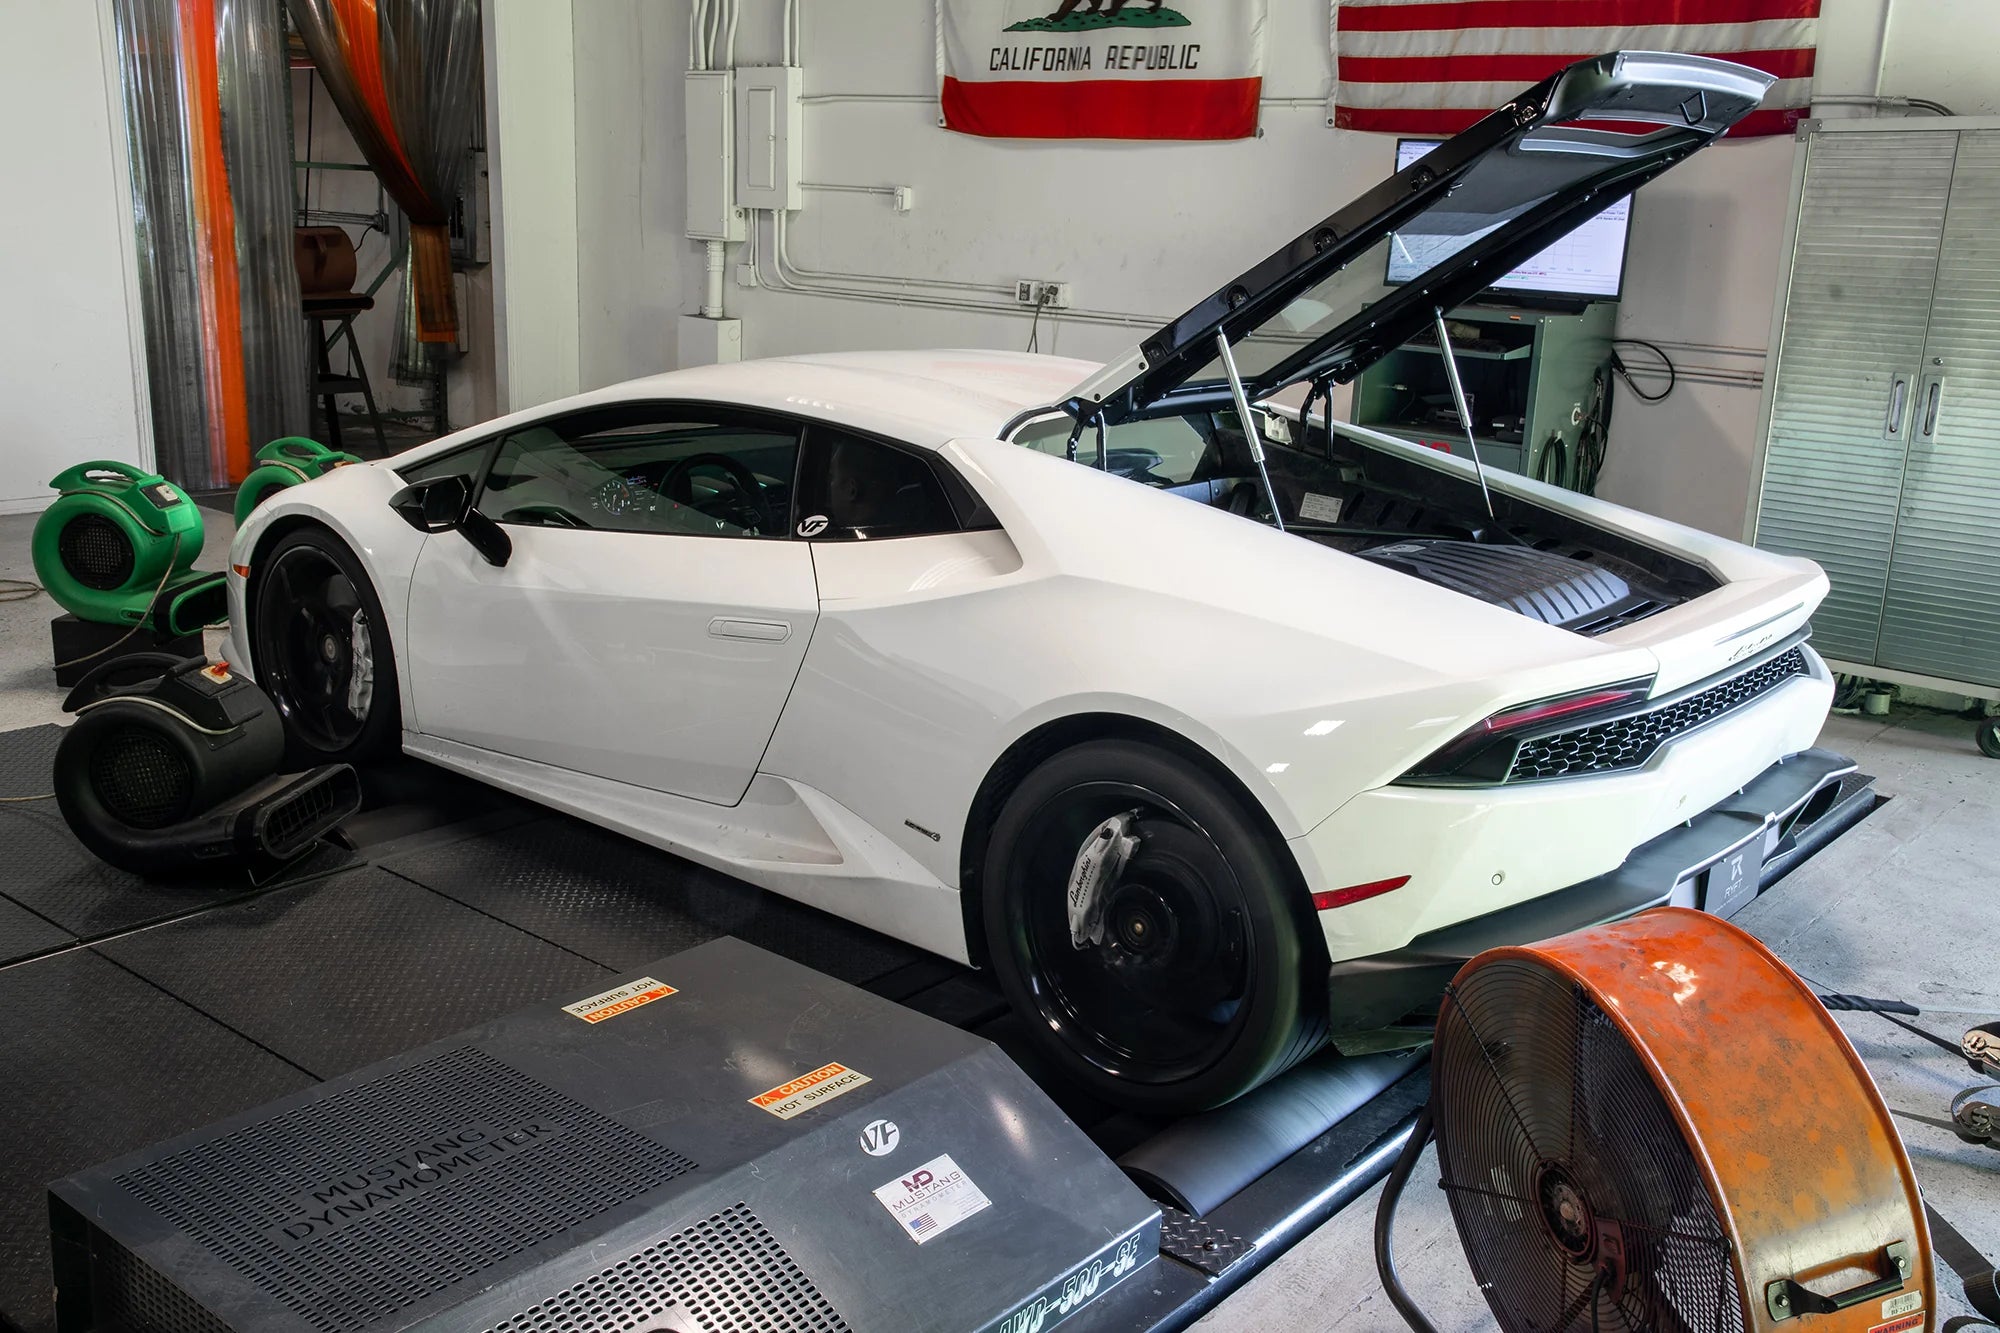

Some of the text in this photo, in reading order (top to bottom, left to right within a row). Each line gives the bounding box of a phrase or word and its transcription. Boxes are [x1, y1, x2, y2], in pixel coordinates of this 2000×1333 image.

[989, 44, 1201, 72] CALIFORNIA REPUBLIC
[799, 518, 829, 534] VF
[1069, 853, 1093, 908] Lamborghini
[572, 980, 656, 1014] HOT SURFACE
[591, 995, 651, 1021] CAUTION
[774, 1073, 861, 1115] HOT SURFACE
[779, 1065, 841, 1095] CAUTION
[860, 1121, 898, 1153] VF
[281, 1123, 552, 1241] DYNAMOMETER
[311, 1128, 486, 1205] MUSTANG
[901, 1169, 934, 1193] MD
[892, 1170, 961, 1211] MUSTANG
[901, 1180, 969, 1219] DYNAMOMETER
